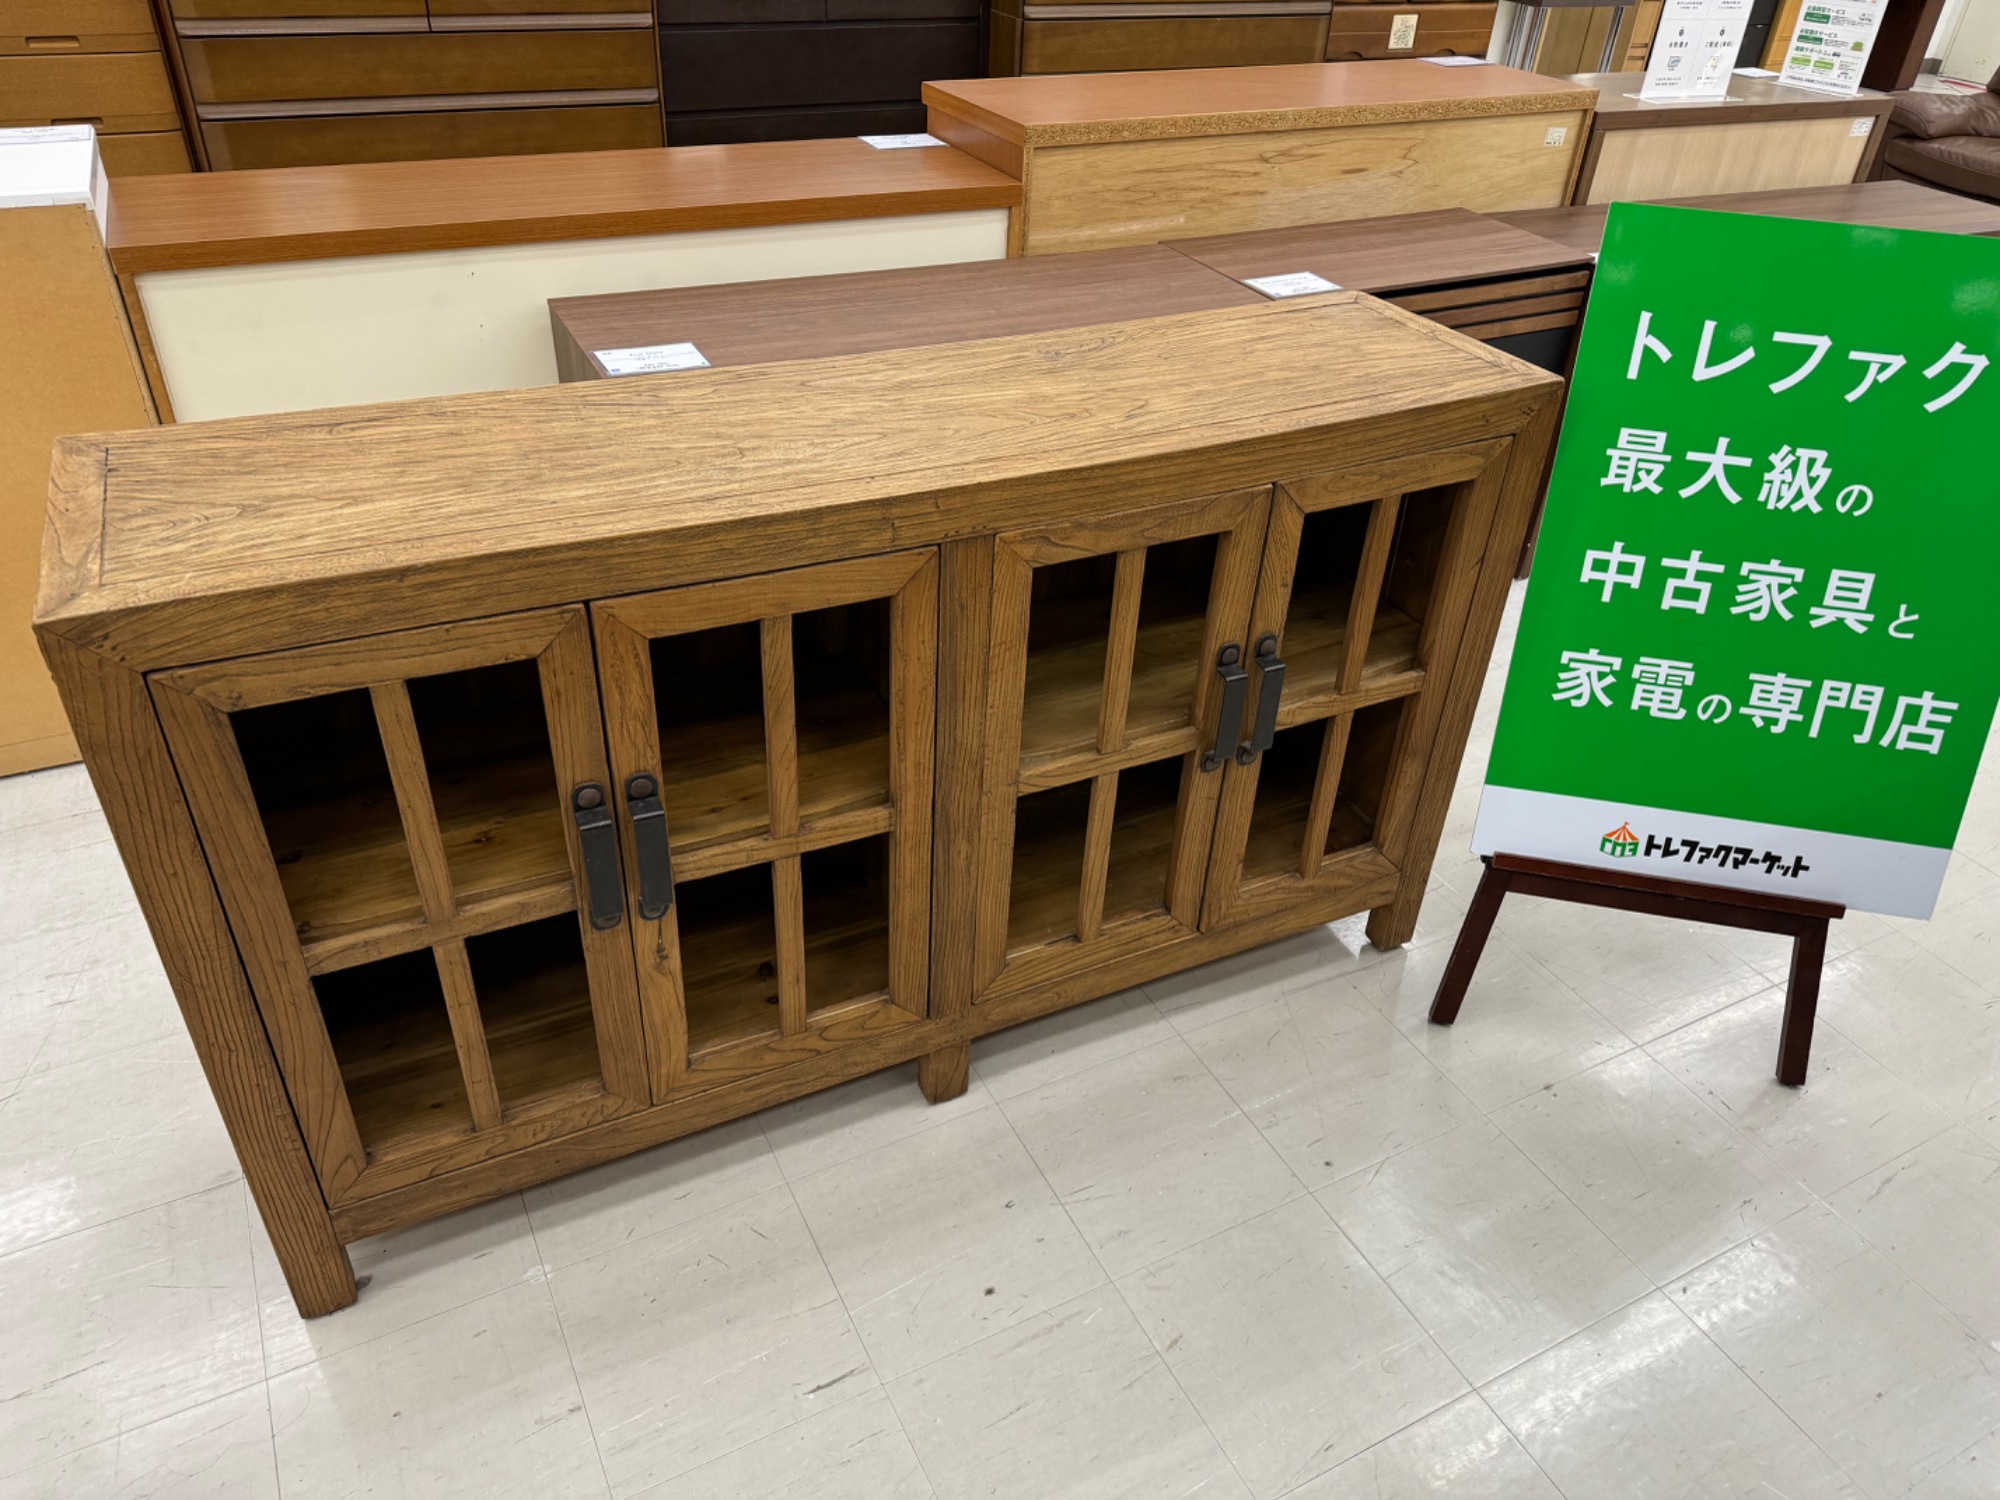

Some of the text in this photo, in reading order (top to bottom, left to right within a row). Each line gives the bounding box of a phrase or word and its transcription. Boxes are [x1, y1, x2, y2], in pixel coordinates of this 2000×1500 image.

[1627, 311, 1990, 412] トレファク
[1601, 428, 1874, 516] 最大級の
[1580, 542, 1919, 639] 中古家具と
[1552, 649, 1959, 755] 家電の専門店
[1644, 834, 1810, 878] トレファクマーケット
